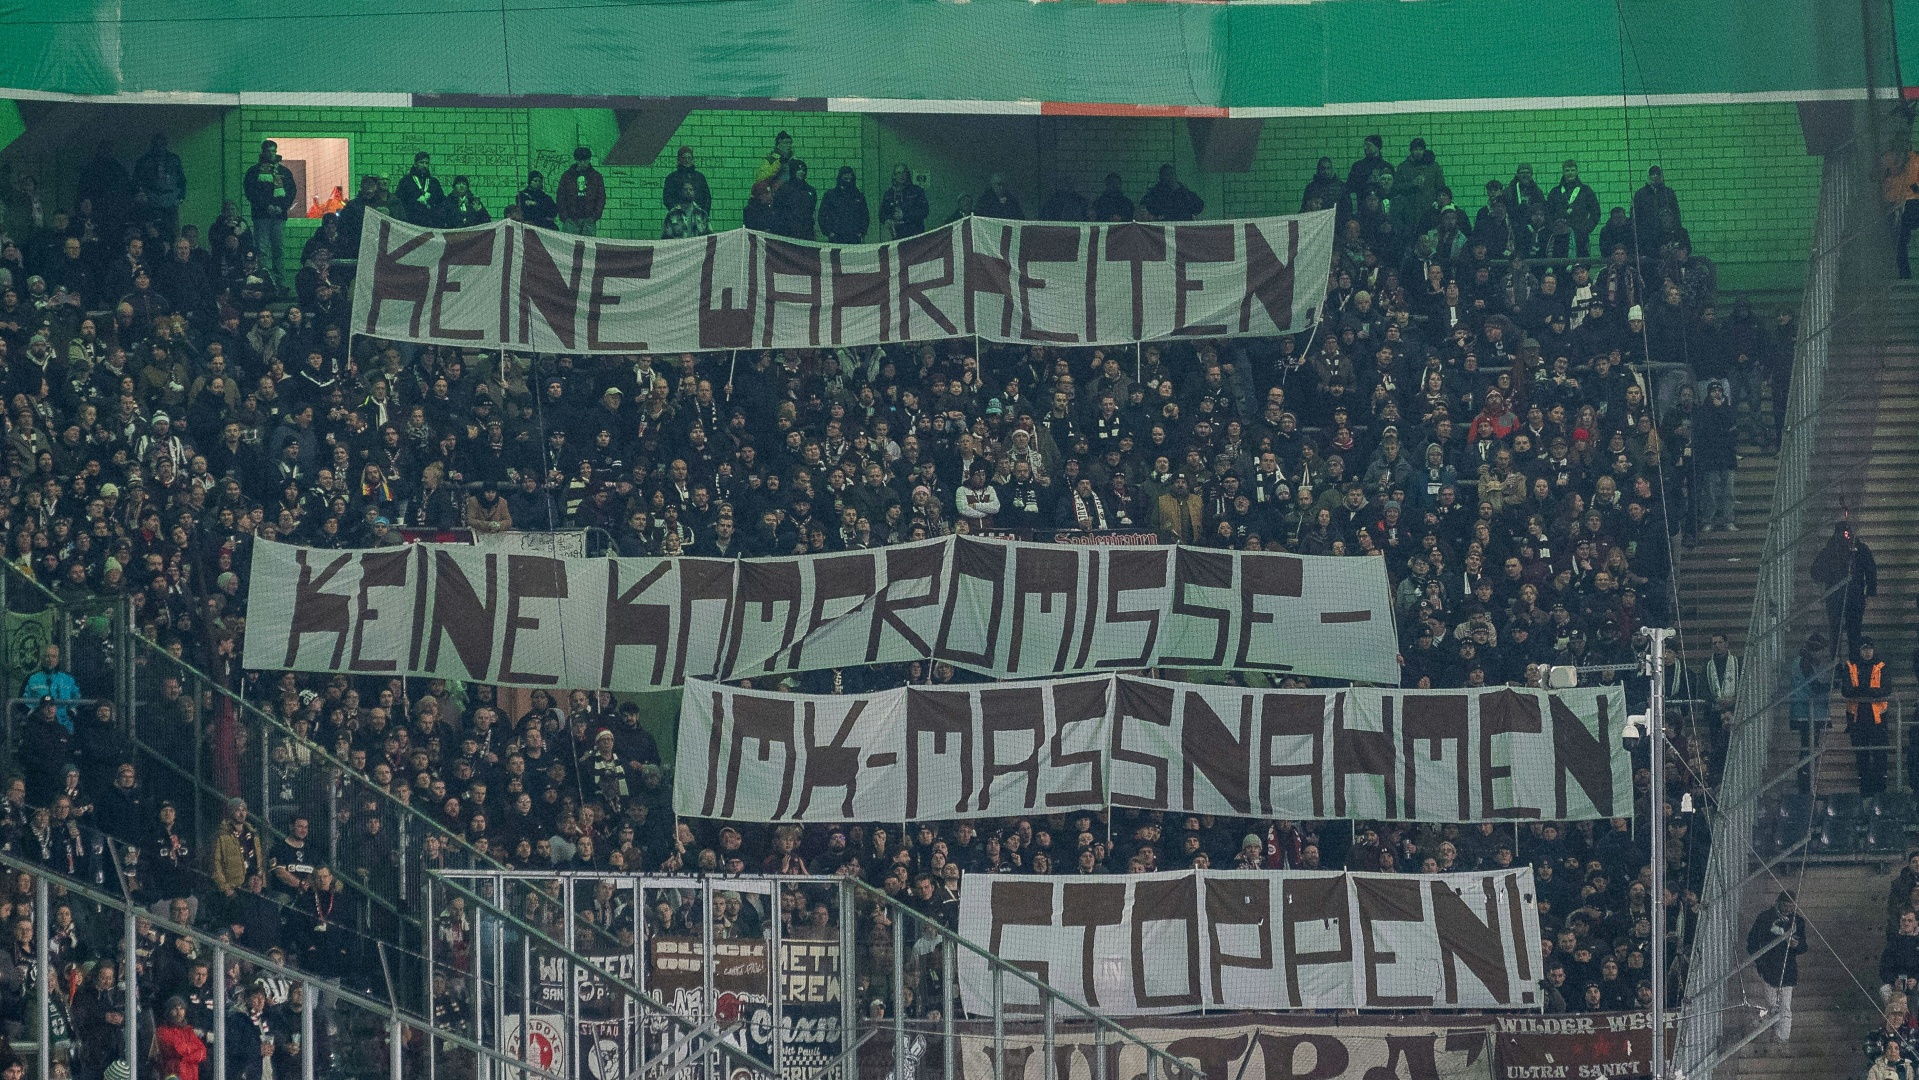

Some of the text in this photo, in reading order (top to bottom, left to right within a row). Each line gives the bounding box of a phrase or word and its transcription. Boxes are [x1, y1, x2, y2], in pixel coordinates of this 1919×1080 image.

[366, 219, 654, 350] KEINE
[284, 544, 568, 684] KEINE
[603, 538, 1303, 688] KOMPROMISSE
[990, 873, 1534, 1014] STOPPEN!
[1498, 1017, 1595, 1035] WILDER
